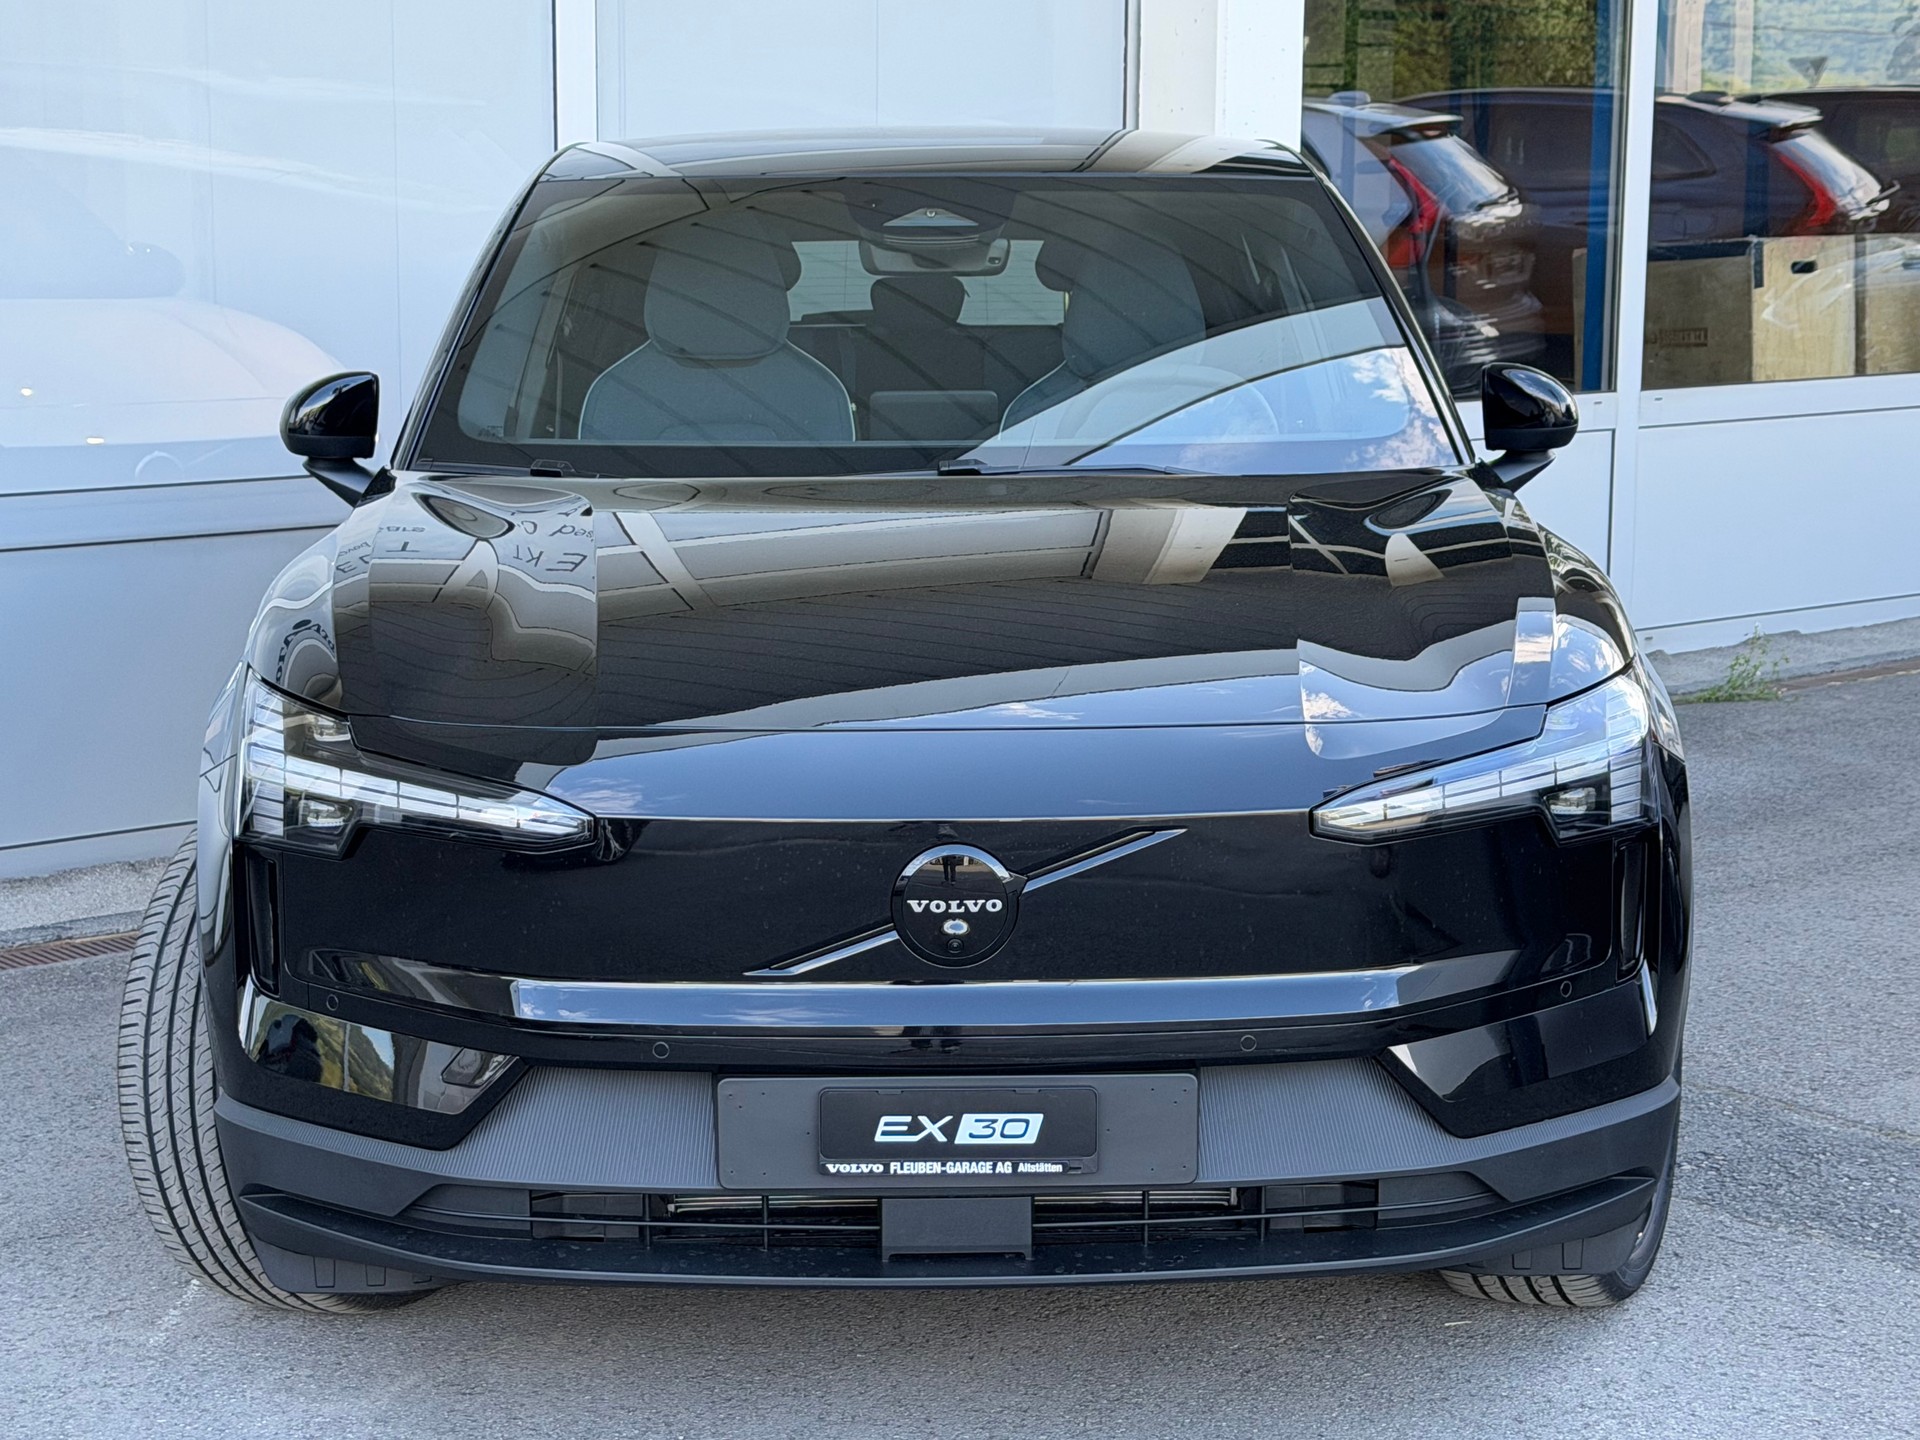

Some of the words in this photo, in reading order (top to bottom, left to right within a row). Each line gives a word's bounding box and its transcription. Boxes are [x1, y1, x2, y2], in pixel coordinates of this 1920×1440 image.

[906, 899, 1003, 913] VOLVO
[874, 1115, 954, 1142] EX
[968, 1118, 1031, 1139] 30
[825, 1163, 884, 1174] VOLVO
[890, 1161, 993, 1175] FLEUBEN-GARAGE
[995, 1161, 1013, 1174] AG
[1017, 1162, 1063, 1173] Altstätten
